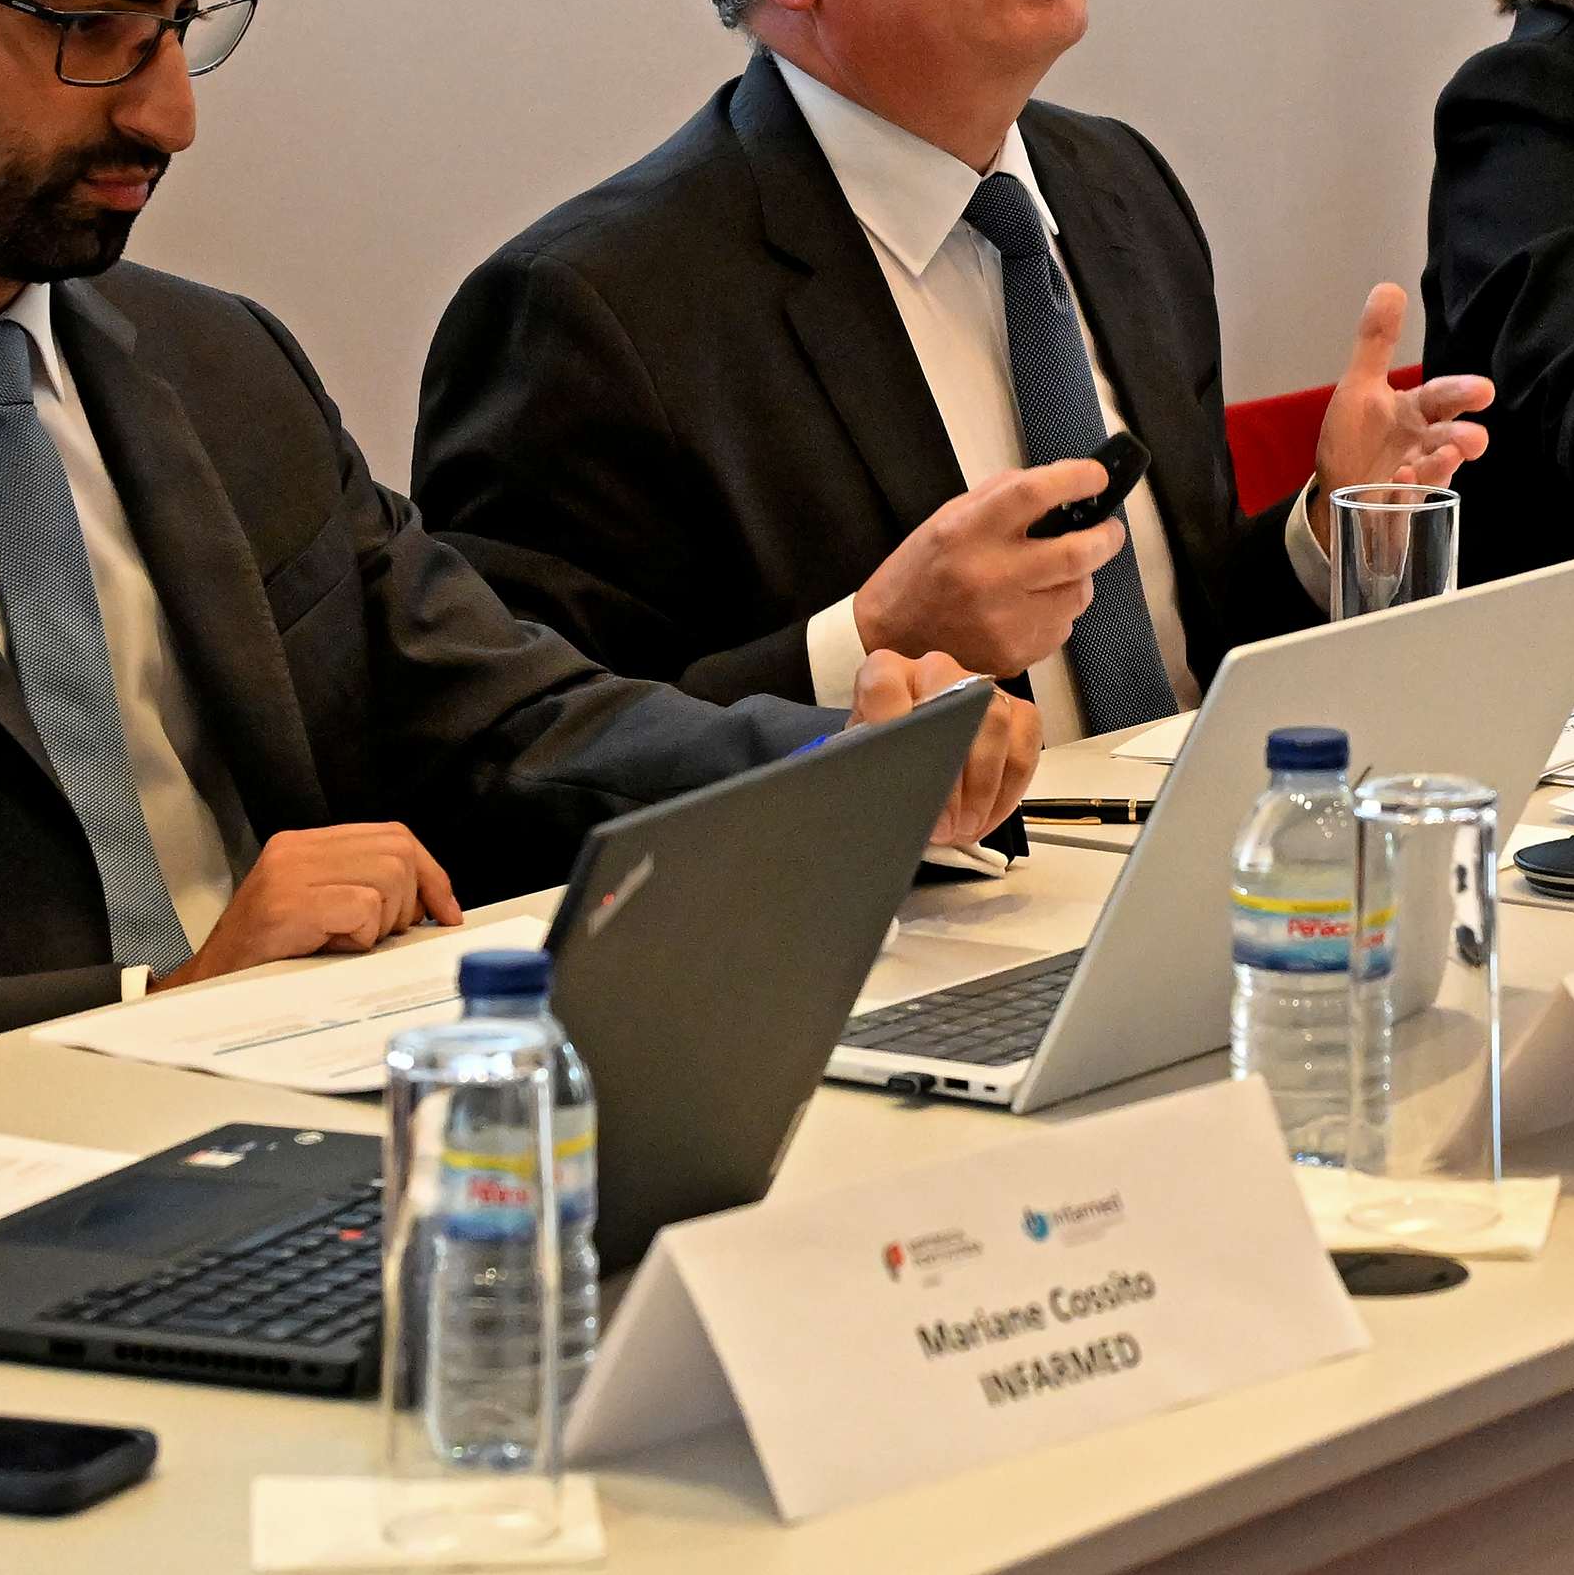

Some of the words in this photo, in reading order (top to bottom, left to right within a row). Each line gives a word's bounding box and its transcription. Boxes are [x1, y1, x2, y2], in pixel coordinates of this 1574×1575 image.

[915, 1301, 1047, 1362] Mariane
[1047, 1269, 1157, 1325] Cossito
[978, 1330, 1143, 1408] INFARMED
